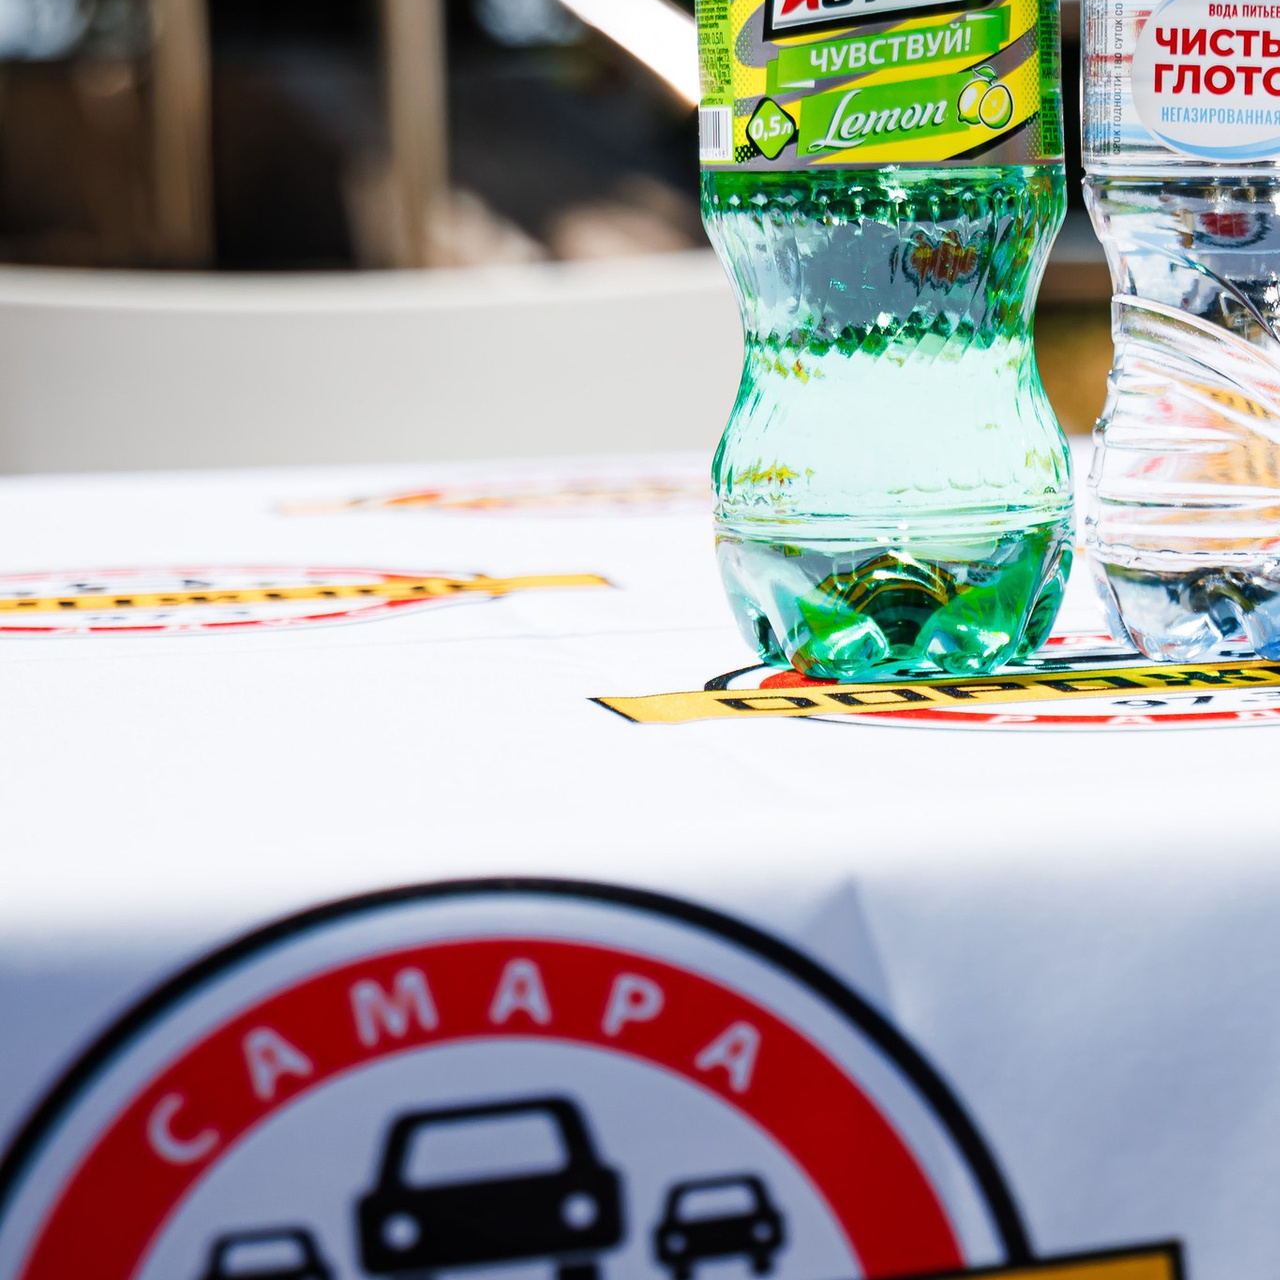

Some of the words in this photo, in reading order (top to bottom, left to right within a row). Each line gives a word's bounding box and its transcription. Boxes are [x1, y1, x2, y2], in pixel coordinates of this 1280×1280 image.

[1115, 2, 1124, 16] СО
[1208, 3, 1239, 19] ВОДА
[809, 23, 972, 74] ЧУВСТВУЙ!
[1114, 18, 1124, 51] СУТОК
[1114, 52, 1123, 70] 180
[807, 88, 949, 153] Lemon
[145, 956, 764, 1166] САМАРА
